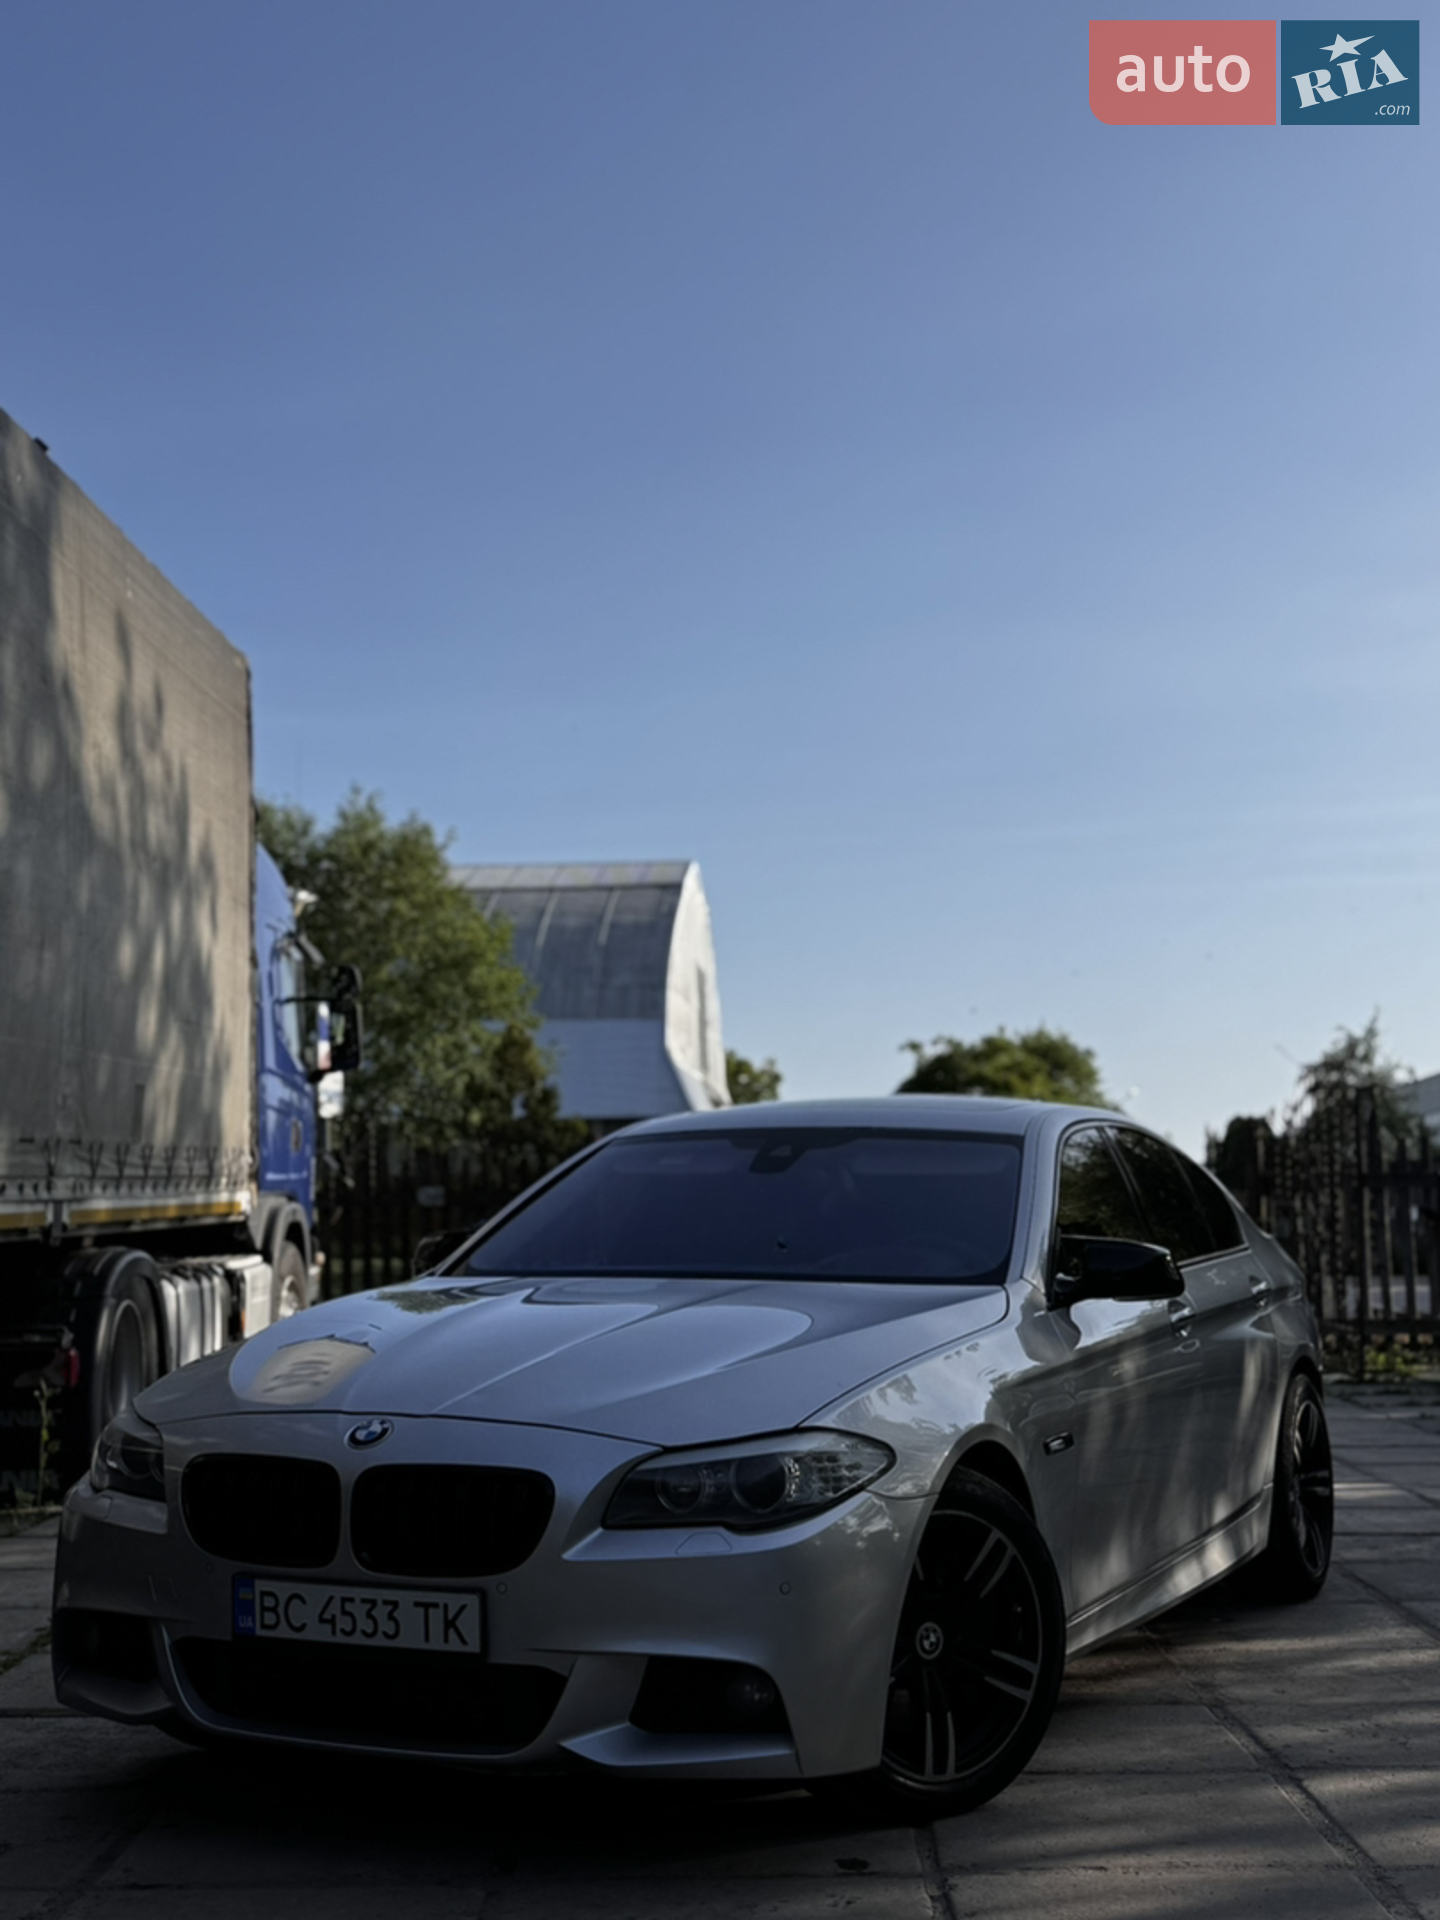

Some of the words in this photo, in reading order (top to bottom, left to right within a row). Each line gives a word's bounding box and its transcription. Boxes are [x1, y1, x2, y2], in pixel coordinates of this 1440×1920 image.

[238, 1614, 254, 1628] UA
[260, 1590, 307, 1633] BC
[318, 1595, 401, 1640] 4533
[414, 1601, 469, 1646] TK
